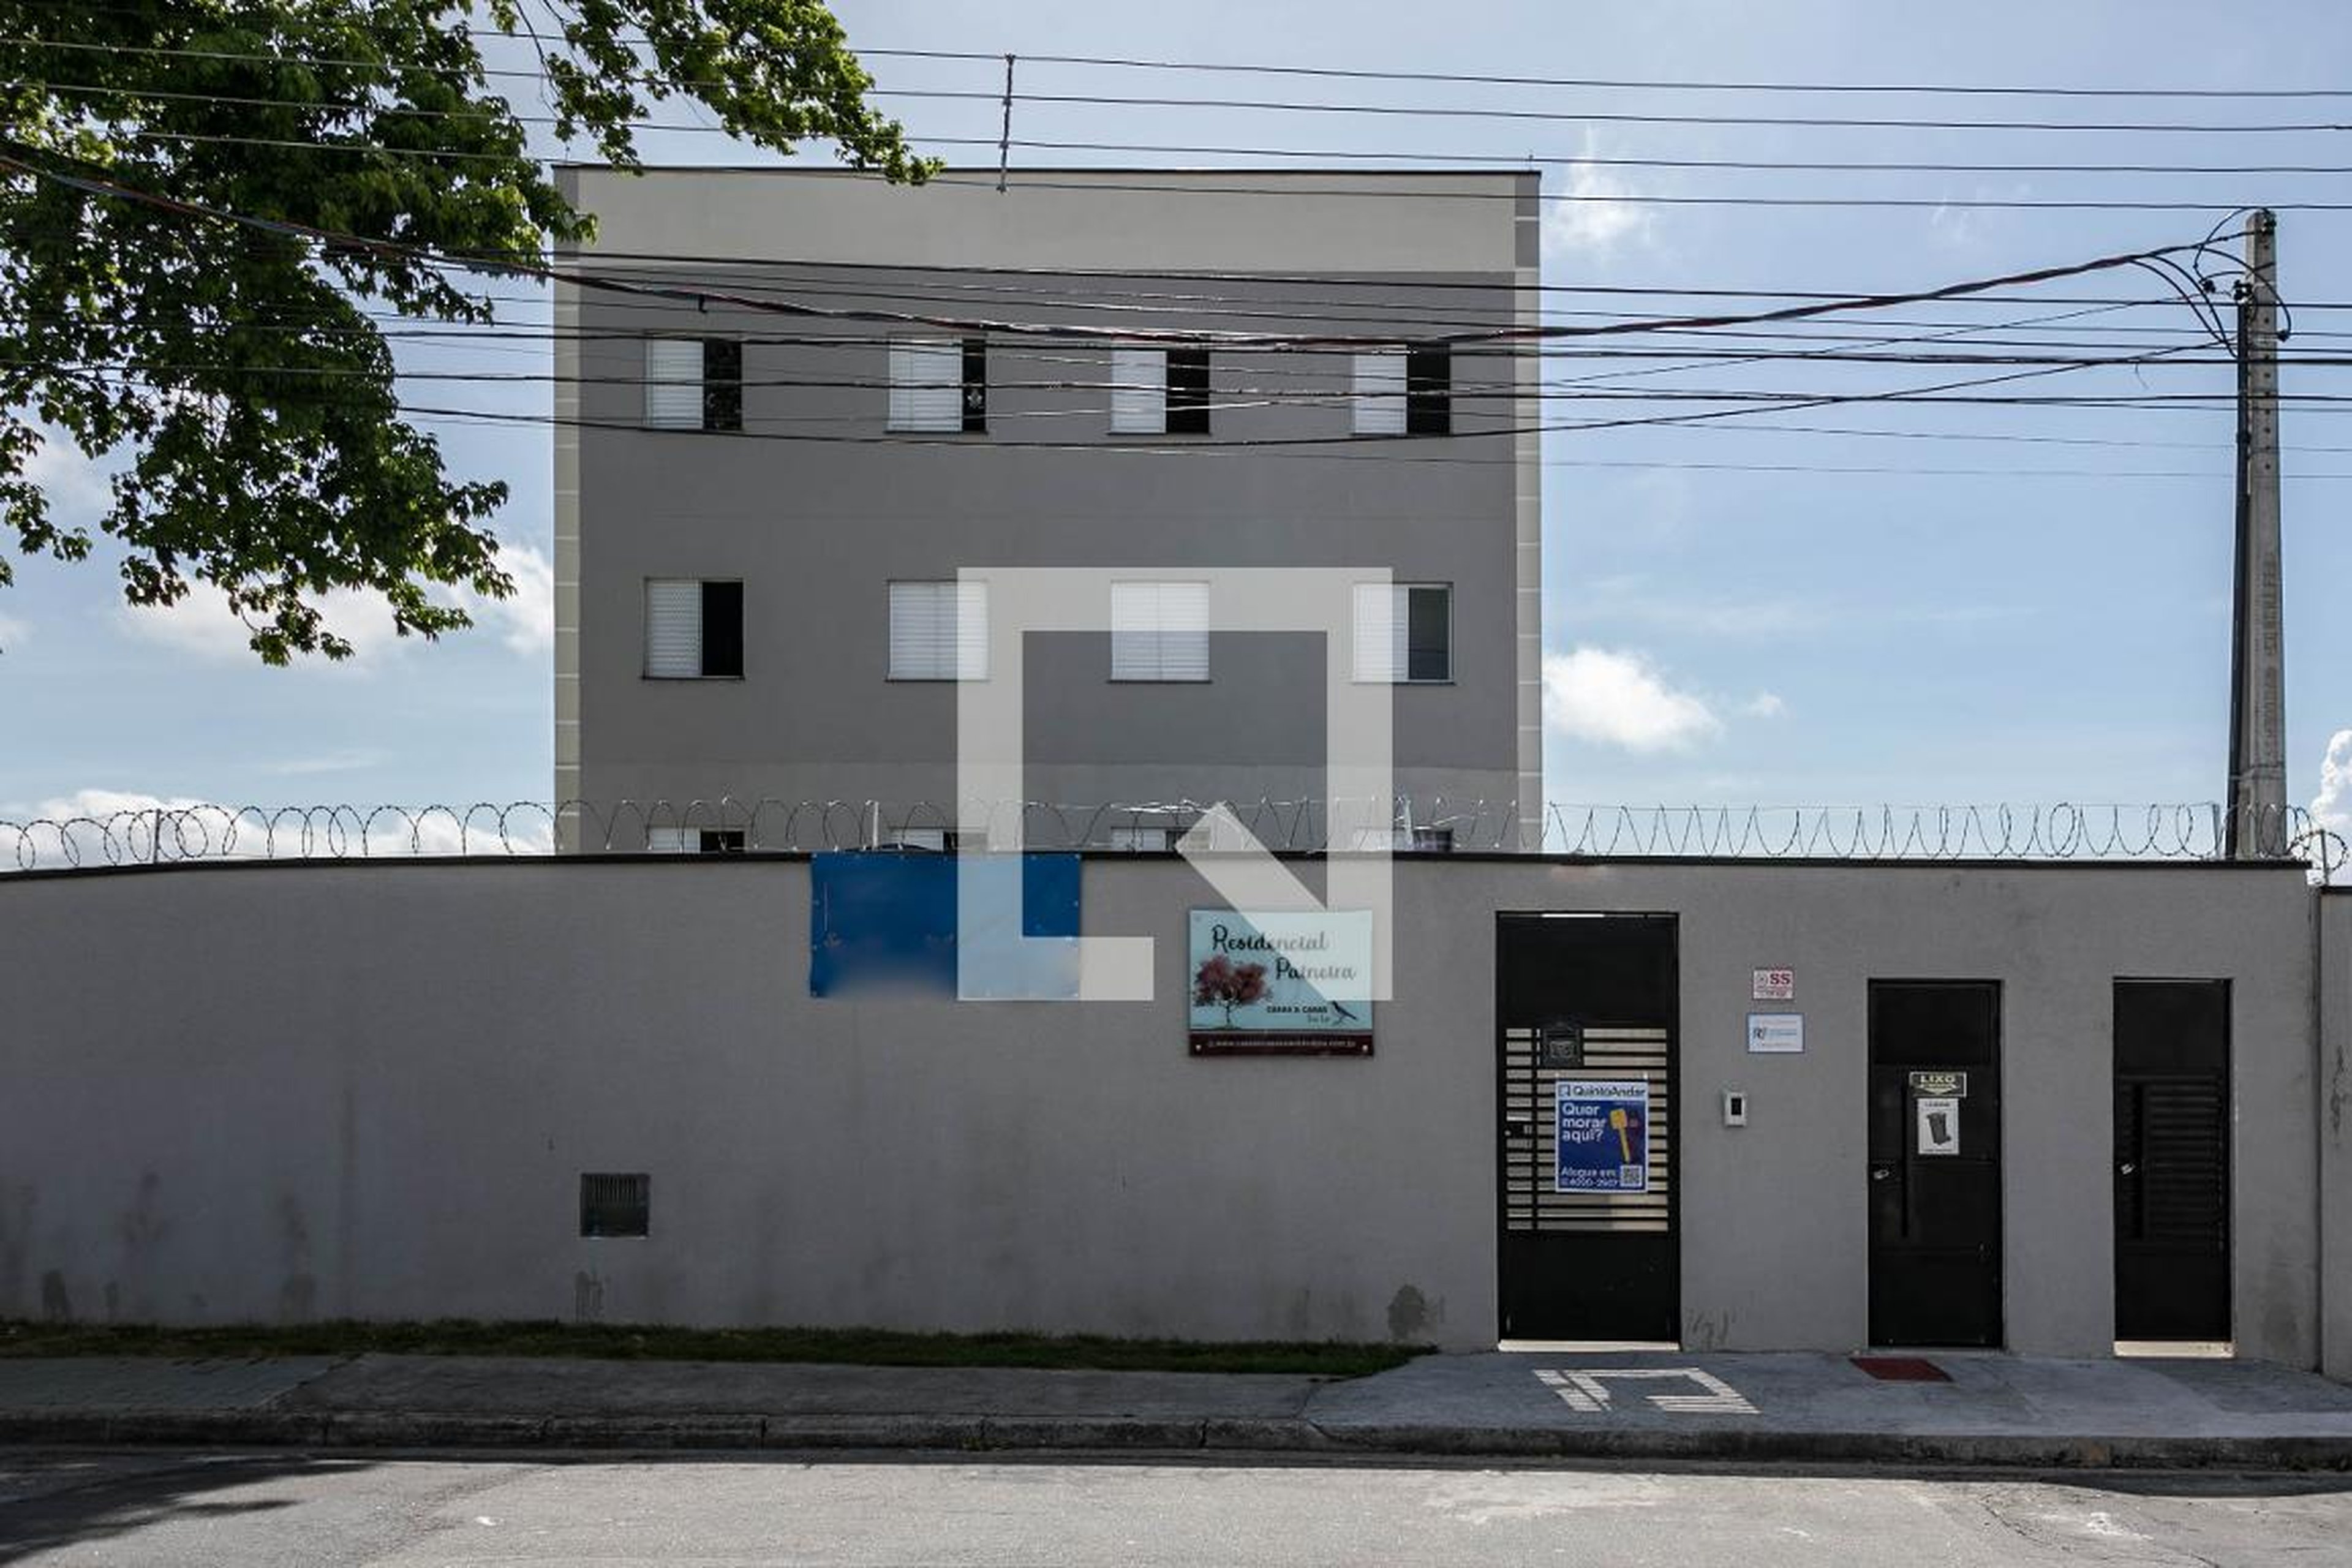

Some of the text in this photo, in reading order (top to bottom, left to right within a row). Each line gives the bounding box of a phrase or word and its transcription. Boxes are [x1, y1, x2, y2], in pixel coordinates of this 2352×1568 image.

[1212, 924, 1330, 953] Residencial
[1275, 957, 1356, 980] Paineira
[1920, 1075, 1955, 1084] LIXO
[1562, 1102, 1600, 1116] Quer
[1562, 1118, 1606, 1128] morar
[1562, 1129, 1604, 1143] aqui?
